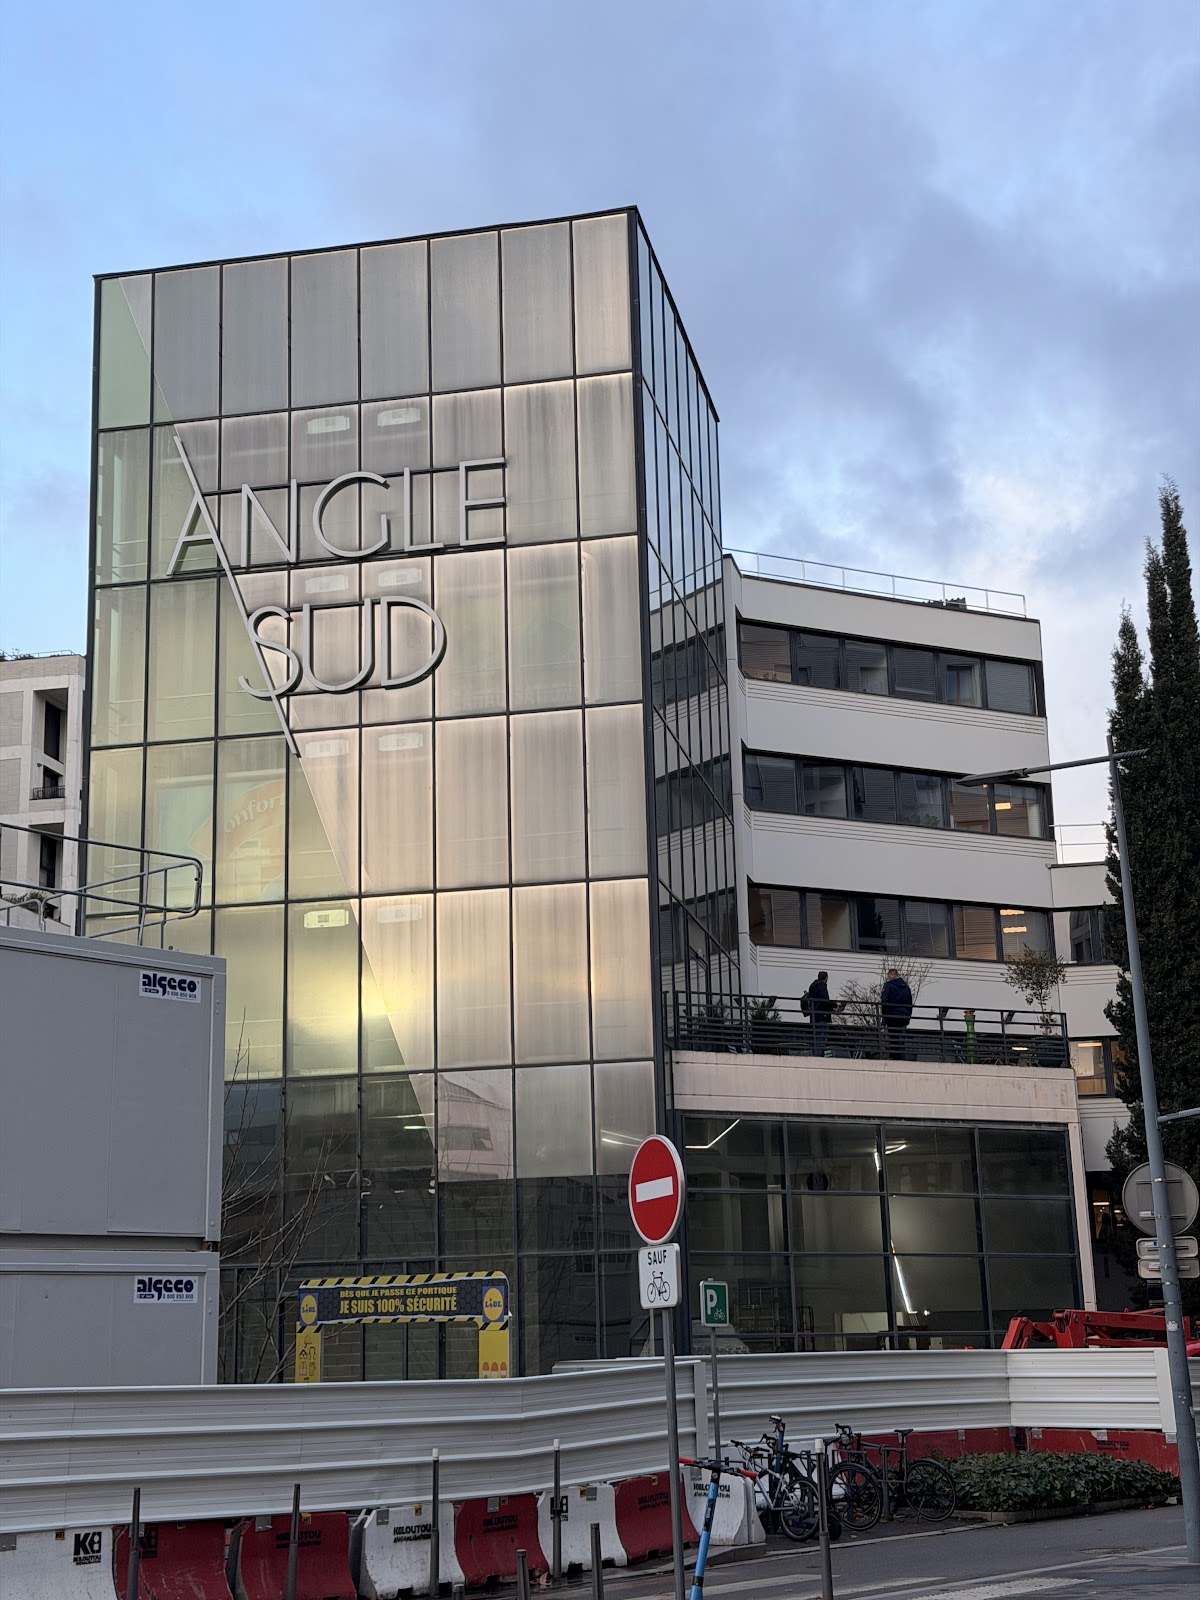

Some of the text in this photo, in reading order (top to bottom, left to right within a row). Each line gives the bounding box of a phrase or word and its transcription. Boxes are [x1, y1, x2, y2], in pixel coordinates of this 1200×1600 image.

[167, 438, 507, 576] ANGLE
[238, 596, 447, 700] SUD
[142, 973, 197, 996] algeco
[647, 1249, 667, 1266] SAUF
[137, 1277, 194, 1301] algeco
[355, 1290, 370, 1298] QUE
[371, 1289, 379, 1297] JE
[380, 1288, 405, 1297] PASSE
[405, 1288, 416, 1296] CE
[417, 1286, 457, 1295] PORTIQUE
[339, 1294, 457, 1314] JE SUIS 100% SÉCURITÉ
[706, 1289, 718, 1315] P
